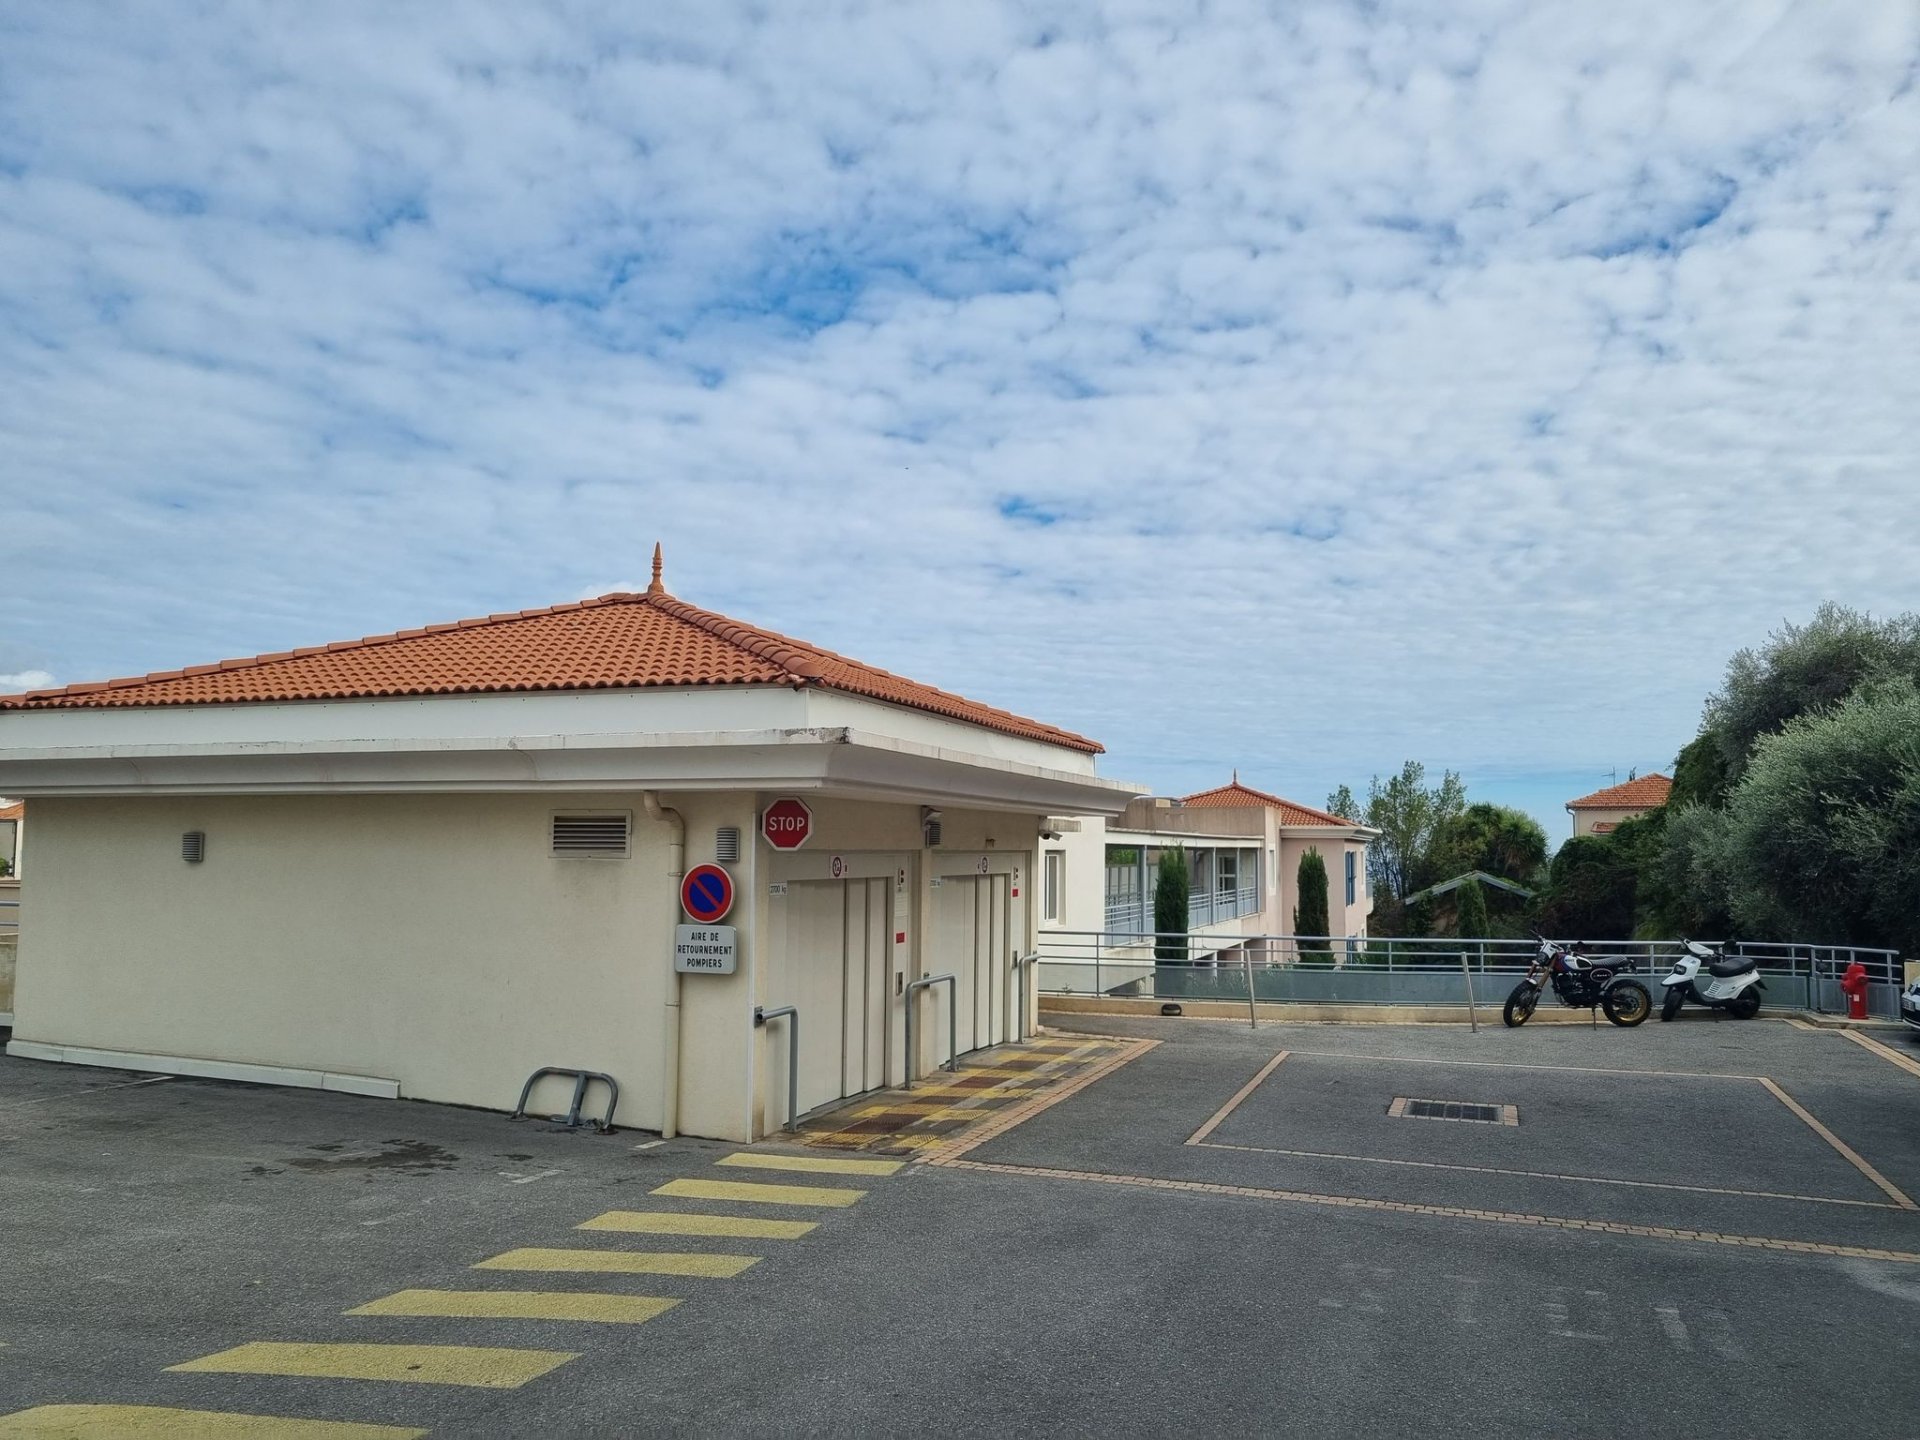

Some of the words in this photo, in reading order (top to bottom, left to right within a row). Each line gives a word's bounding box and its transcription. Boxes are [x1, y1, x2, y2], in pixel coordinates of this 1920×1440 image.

[769, 817, 805, 831] STOP
[691, 932, 707, 941] AIRE
[710, 932, 719, 941] DE
[677, 944, 732, 955] RETOURNEMENT
[687, 958, 723, 968] POMPIERS
